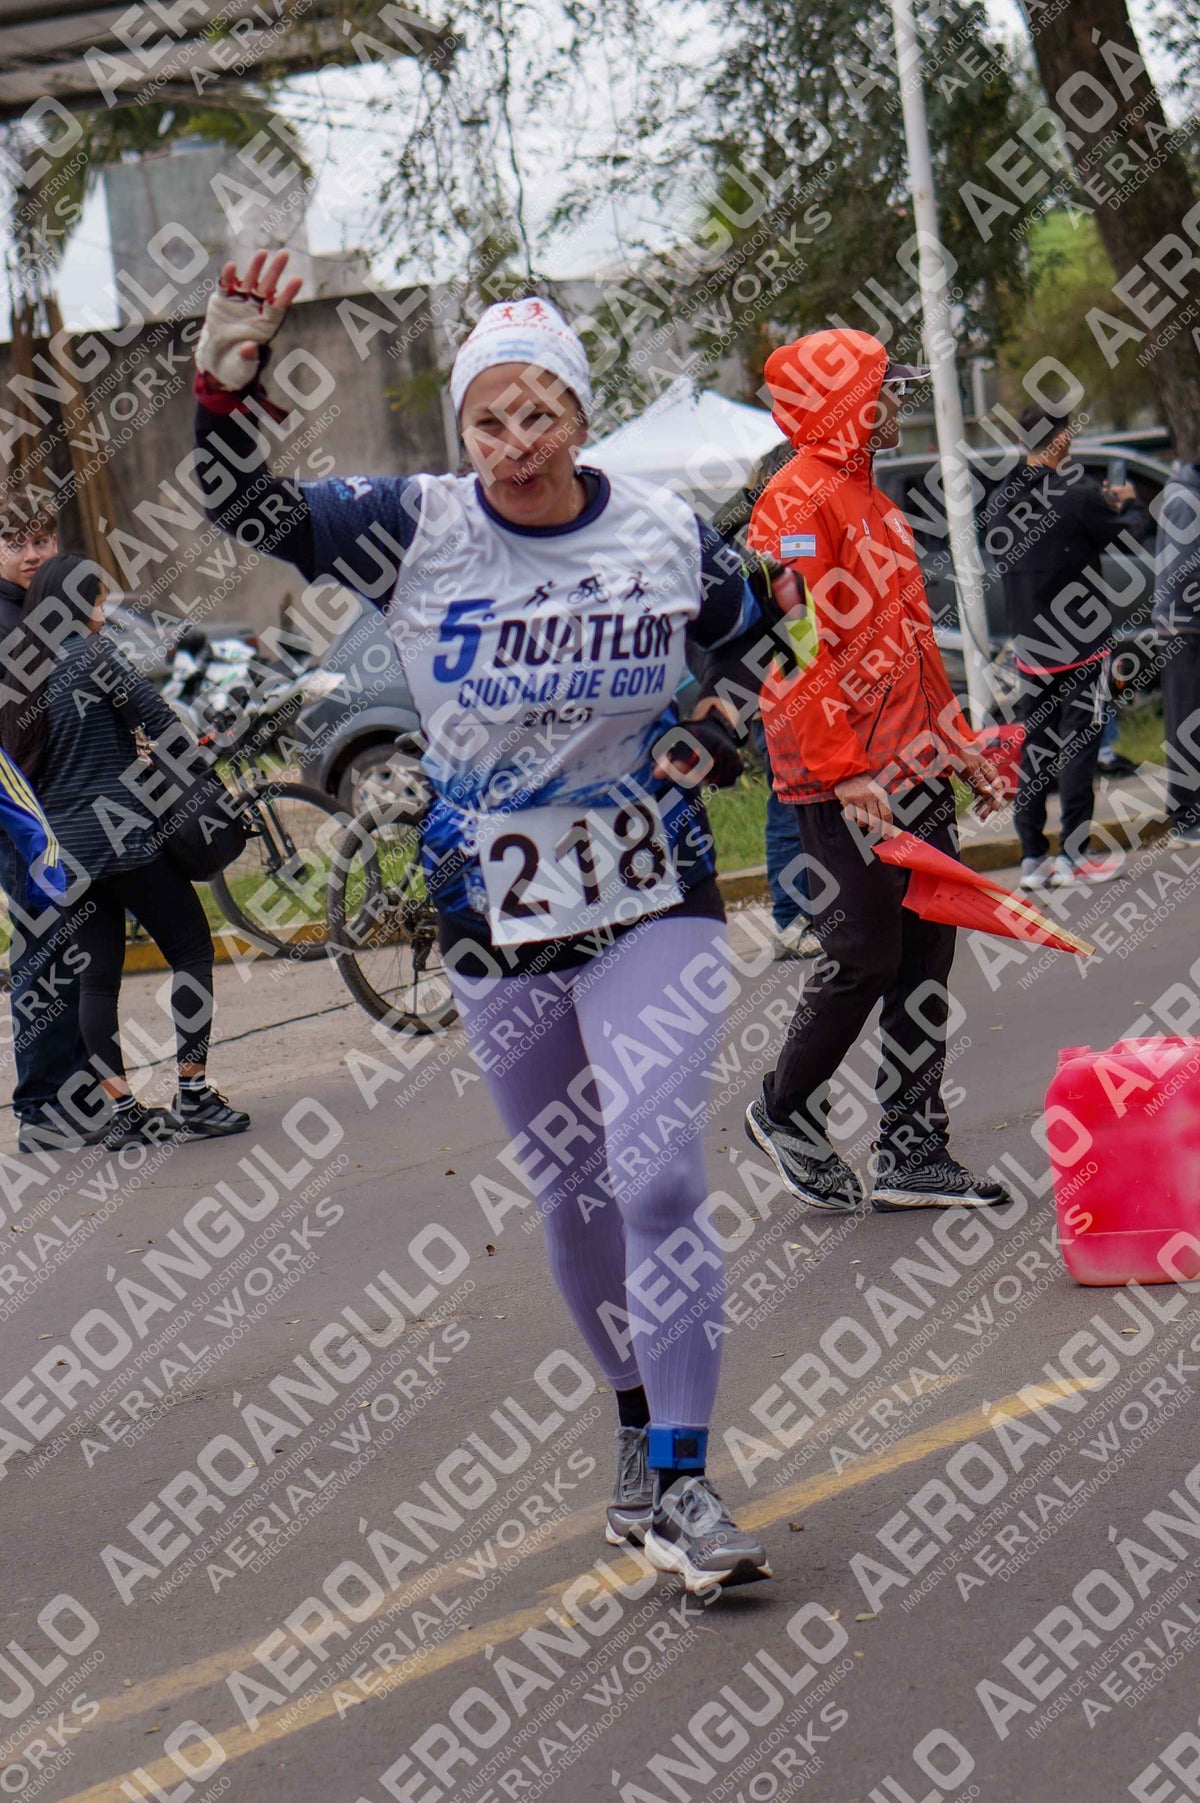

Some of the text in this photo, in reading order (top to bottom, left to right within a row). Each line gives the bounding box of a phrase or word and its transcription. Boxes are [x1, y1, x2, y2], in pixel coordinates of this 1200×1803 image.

[491, 606, 673, 670] DUATLÓN
[457, 663, 667, 709] CIUDAD DE GOYA
[488, 803, 668, 922] 218
